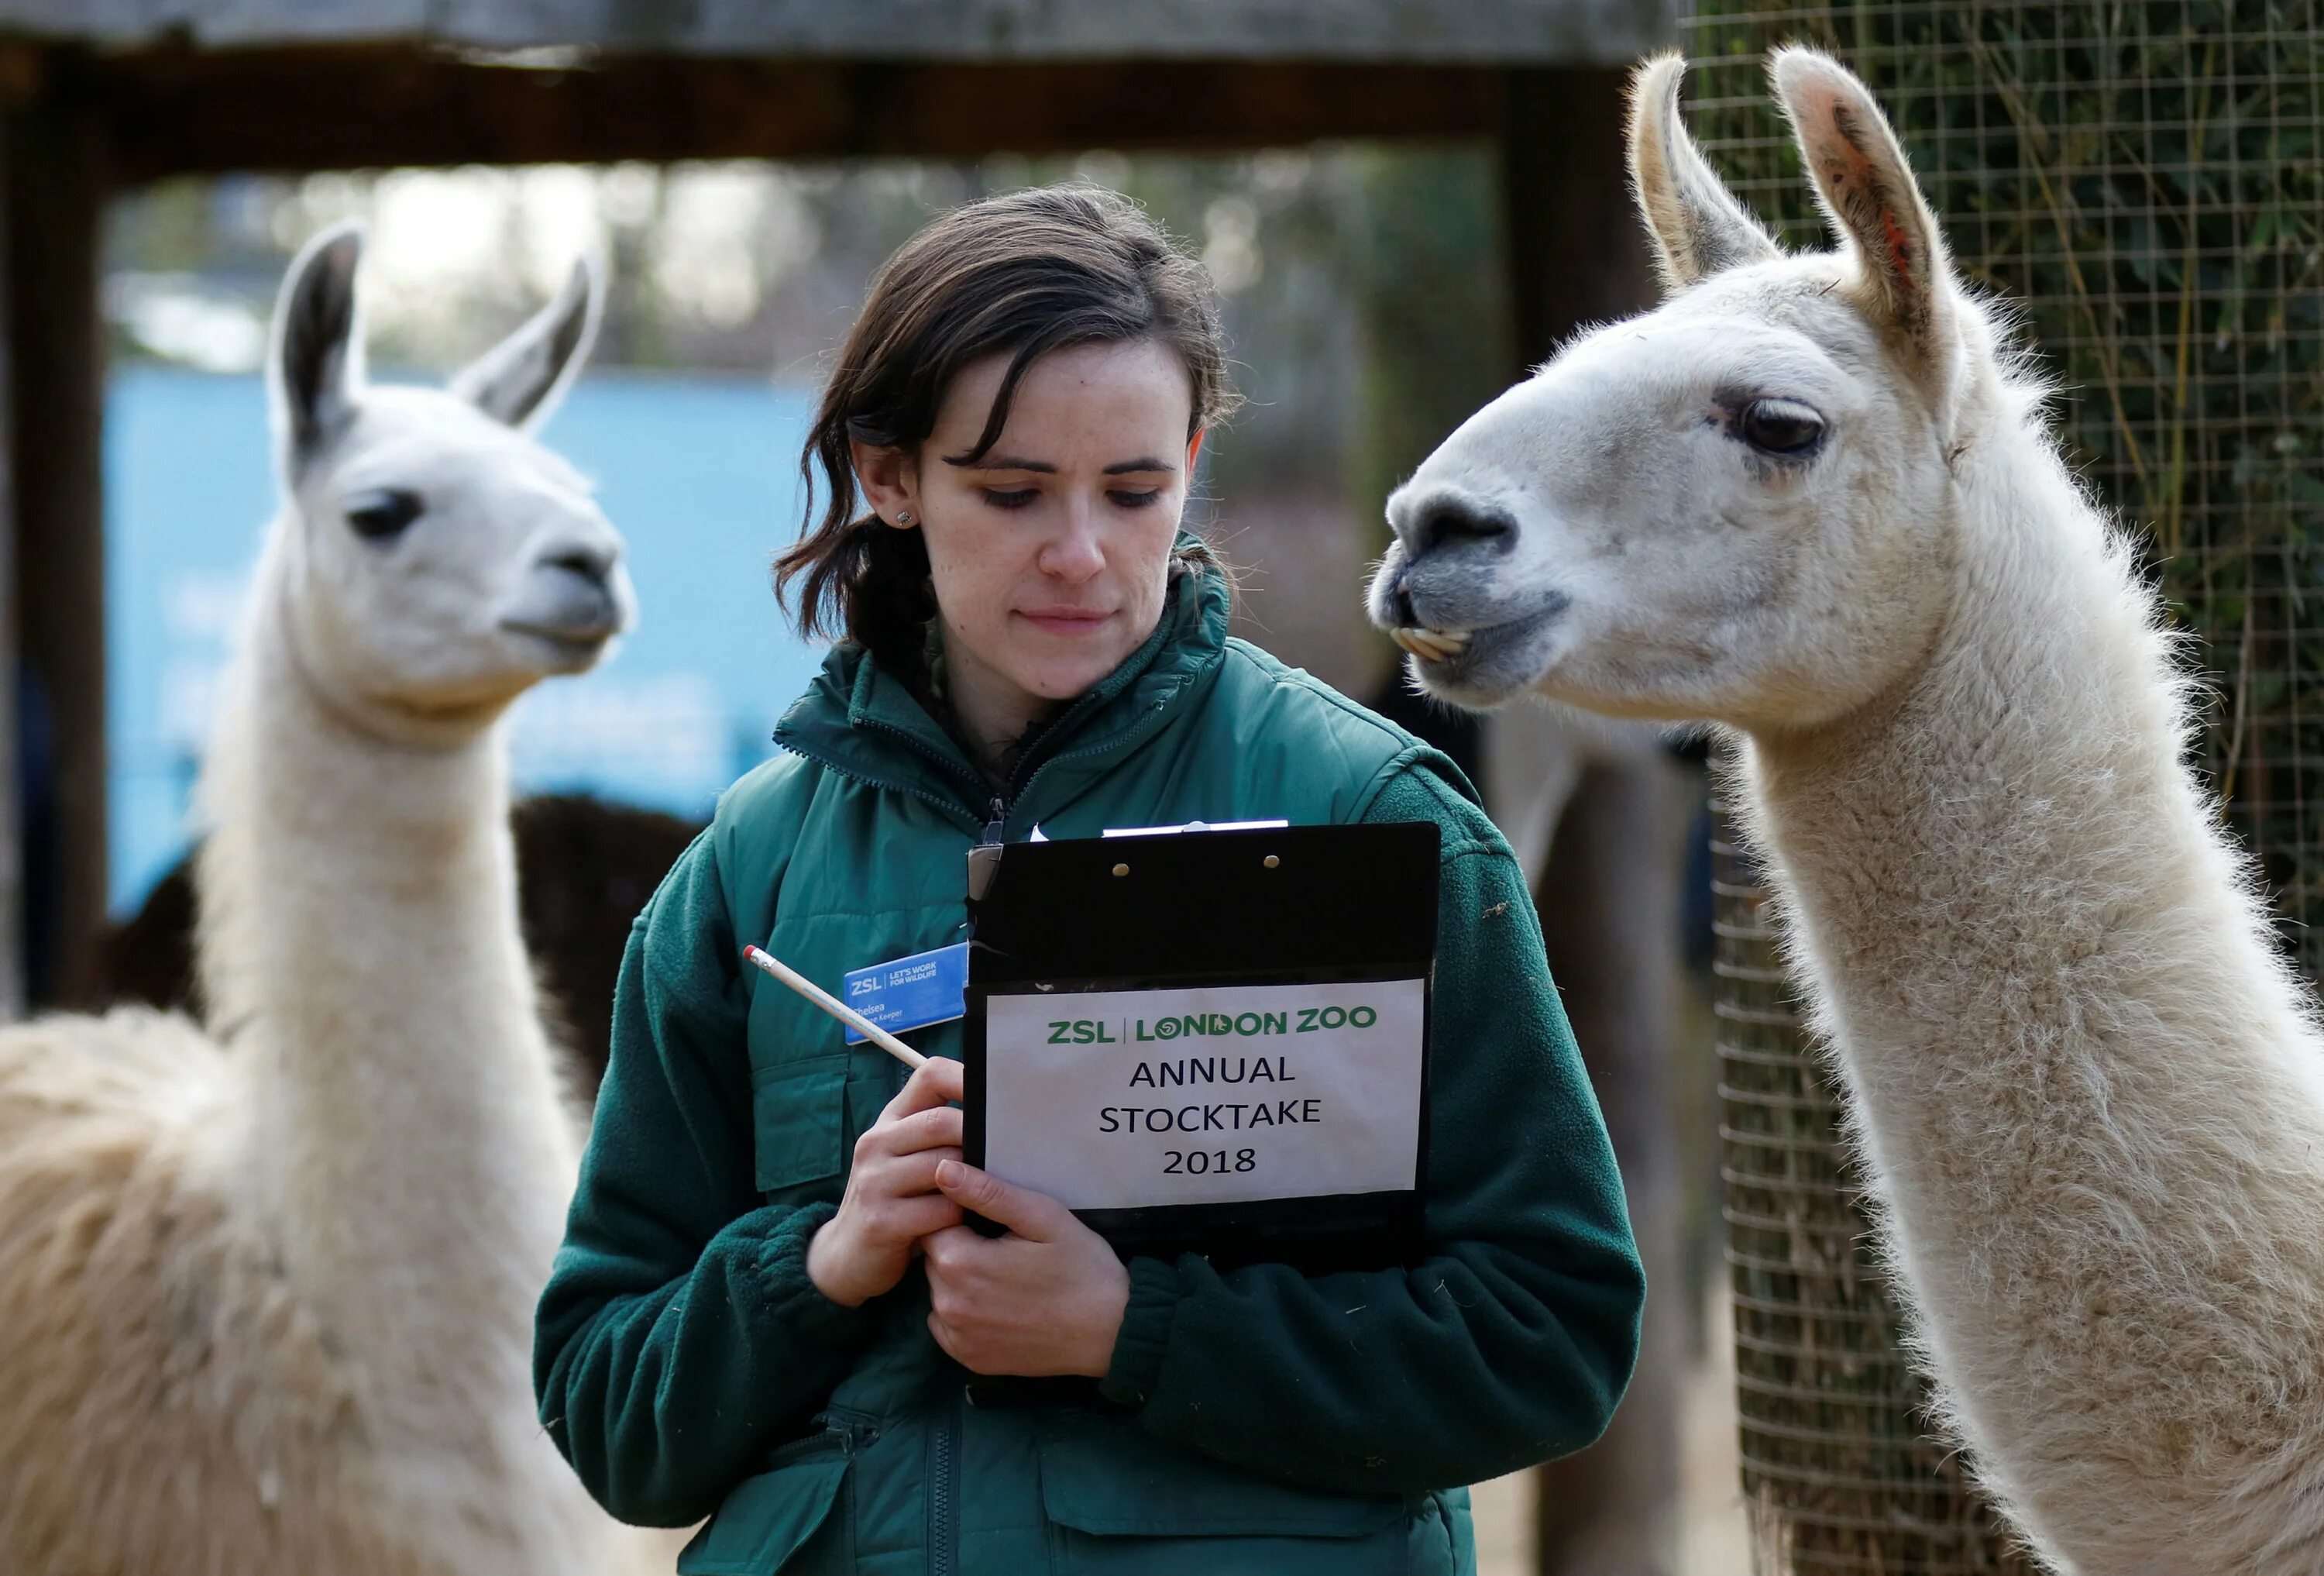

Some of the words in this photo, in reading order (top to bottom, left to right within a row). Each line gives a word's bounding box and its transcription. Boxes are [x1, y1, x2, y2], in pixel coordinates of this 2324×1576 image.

[889, 968, 911, 980] LET'S
[912, 962, 937, 974] WORK
[890, 978, 905, 987] FOR
[905, 969, 937, 982] WILDLIFE
[851, 976, 882, 996] ZSL
[879, 1010, 902, 1021] Keeper
[1047, 1020, 1116, 1044] ZSL
[1136, 1011, 1287, 1041] LONDON
[1296, 1005, 1377, 1033] ZOO
[1129, 1056, 1295, 1088] ANNUAL
[1099, 1099, 1321, 1134] STOCKTAKE
[1163, 1148, 1257, 1175] 2018
